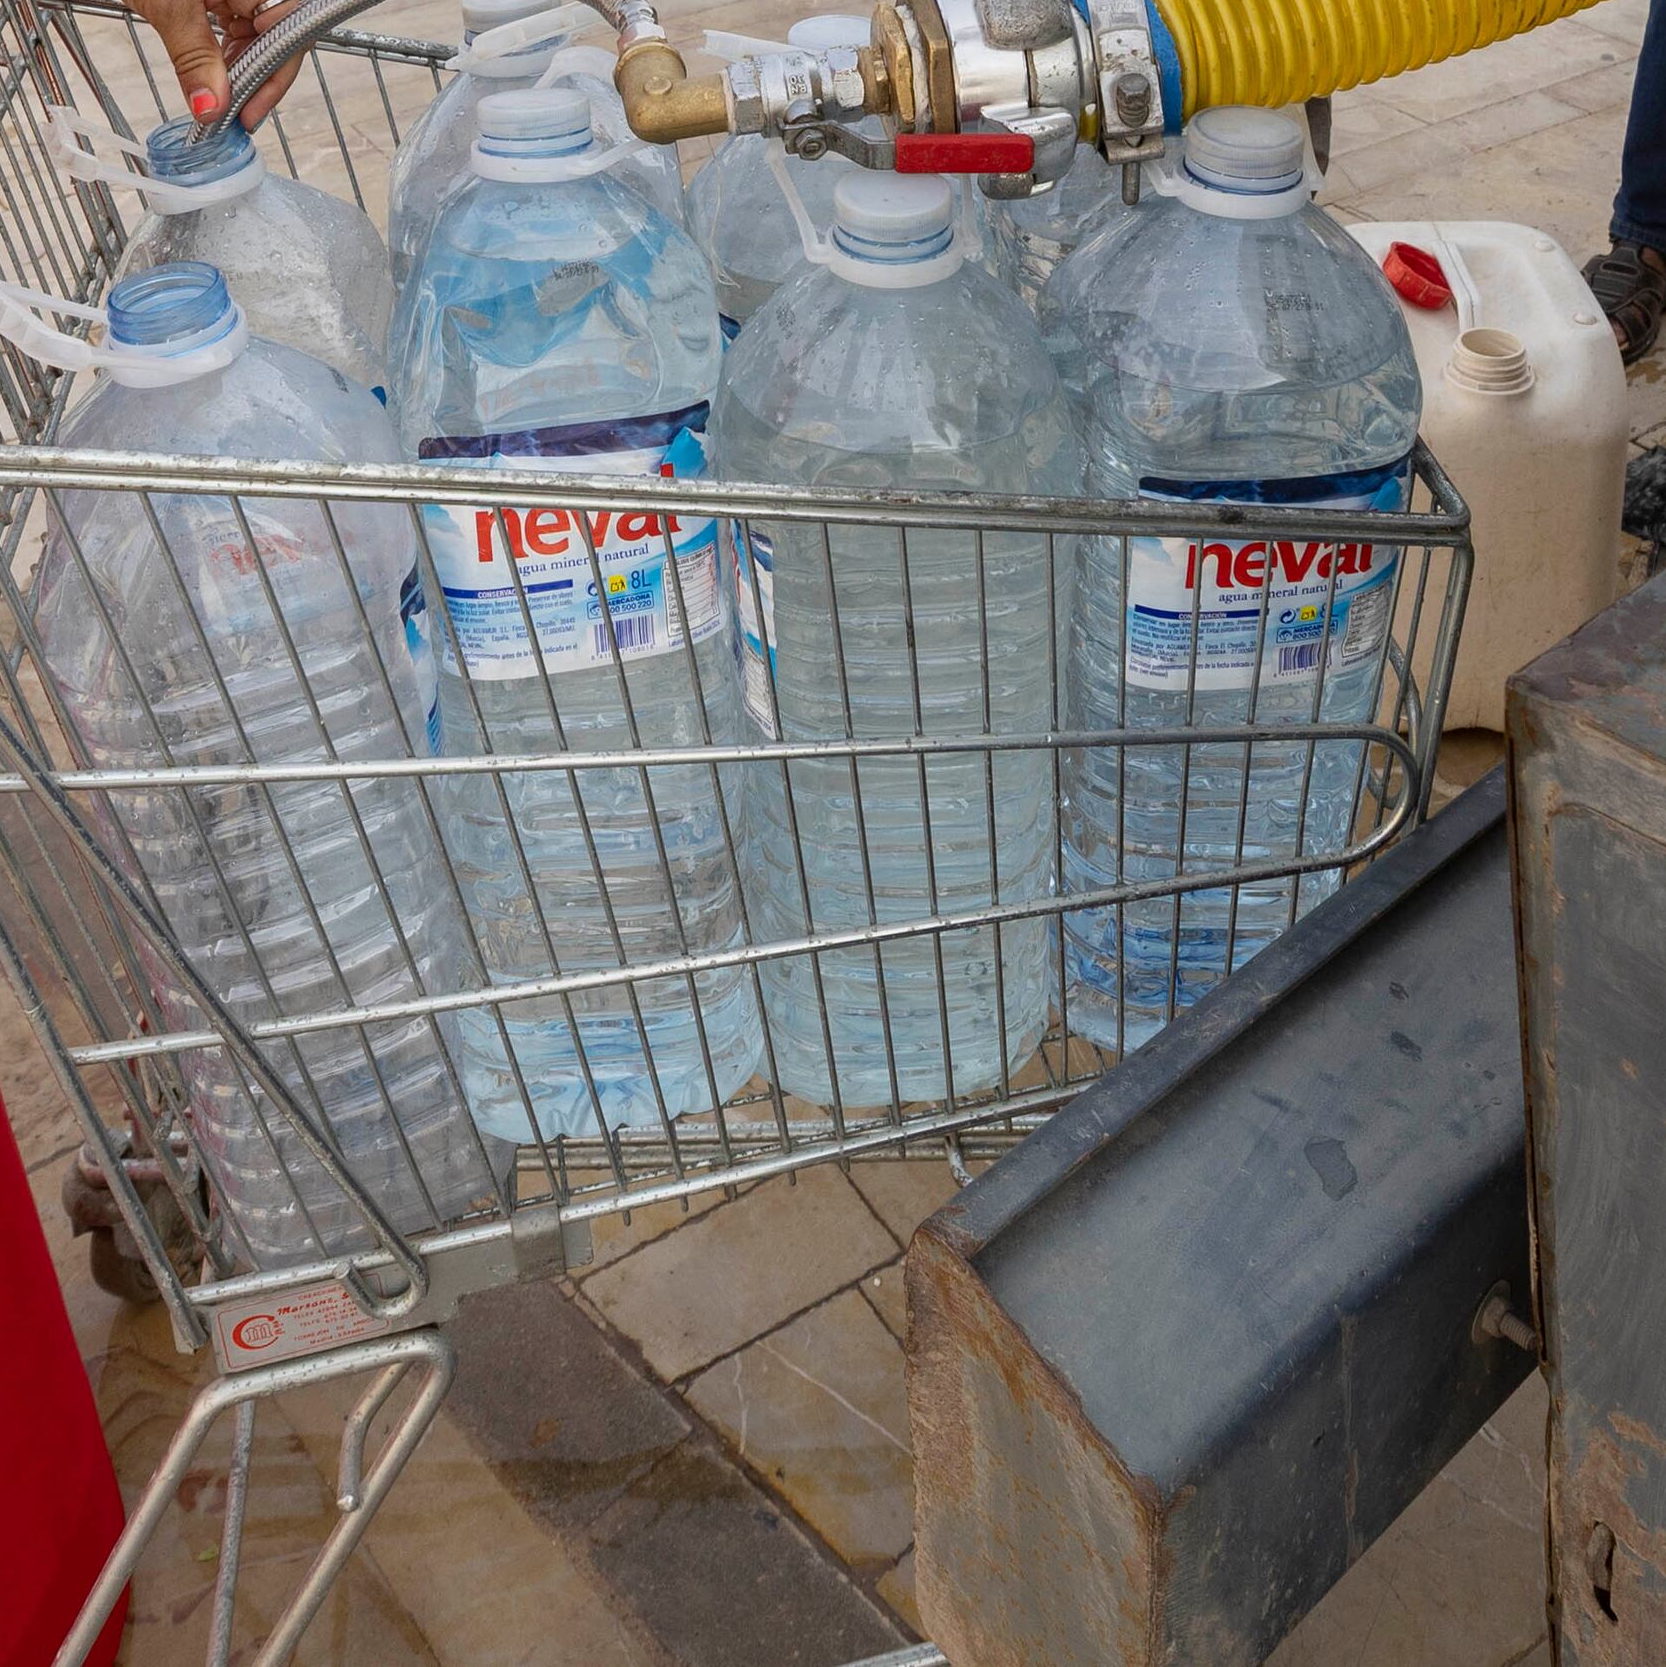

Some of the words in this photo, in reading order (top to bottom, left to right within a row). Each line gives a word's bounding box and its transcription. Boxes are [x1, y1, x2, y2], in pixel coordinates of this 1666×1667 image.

[550, 553, 600, 570] minerl
[604, 543, 649, 564] natural
[631, 569, 652, 589] 8L
[1218, 590, 1248, 604] agua
[1251, 585, 1298, 601] mneral
[621, 603, 637, 612] 500
[637, 600, 652, 609] 220
